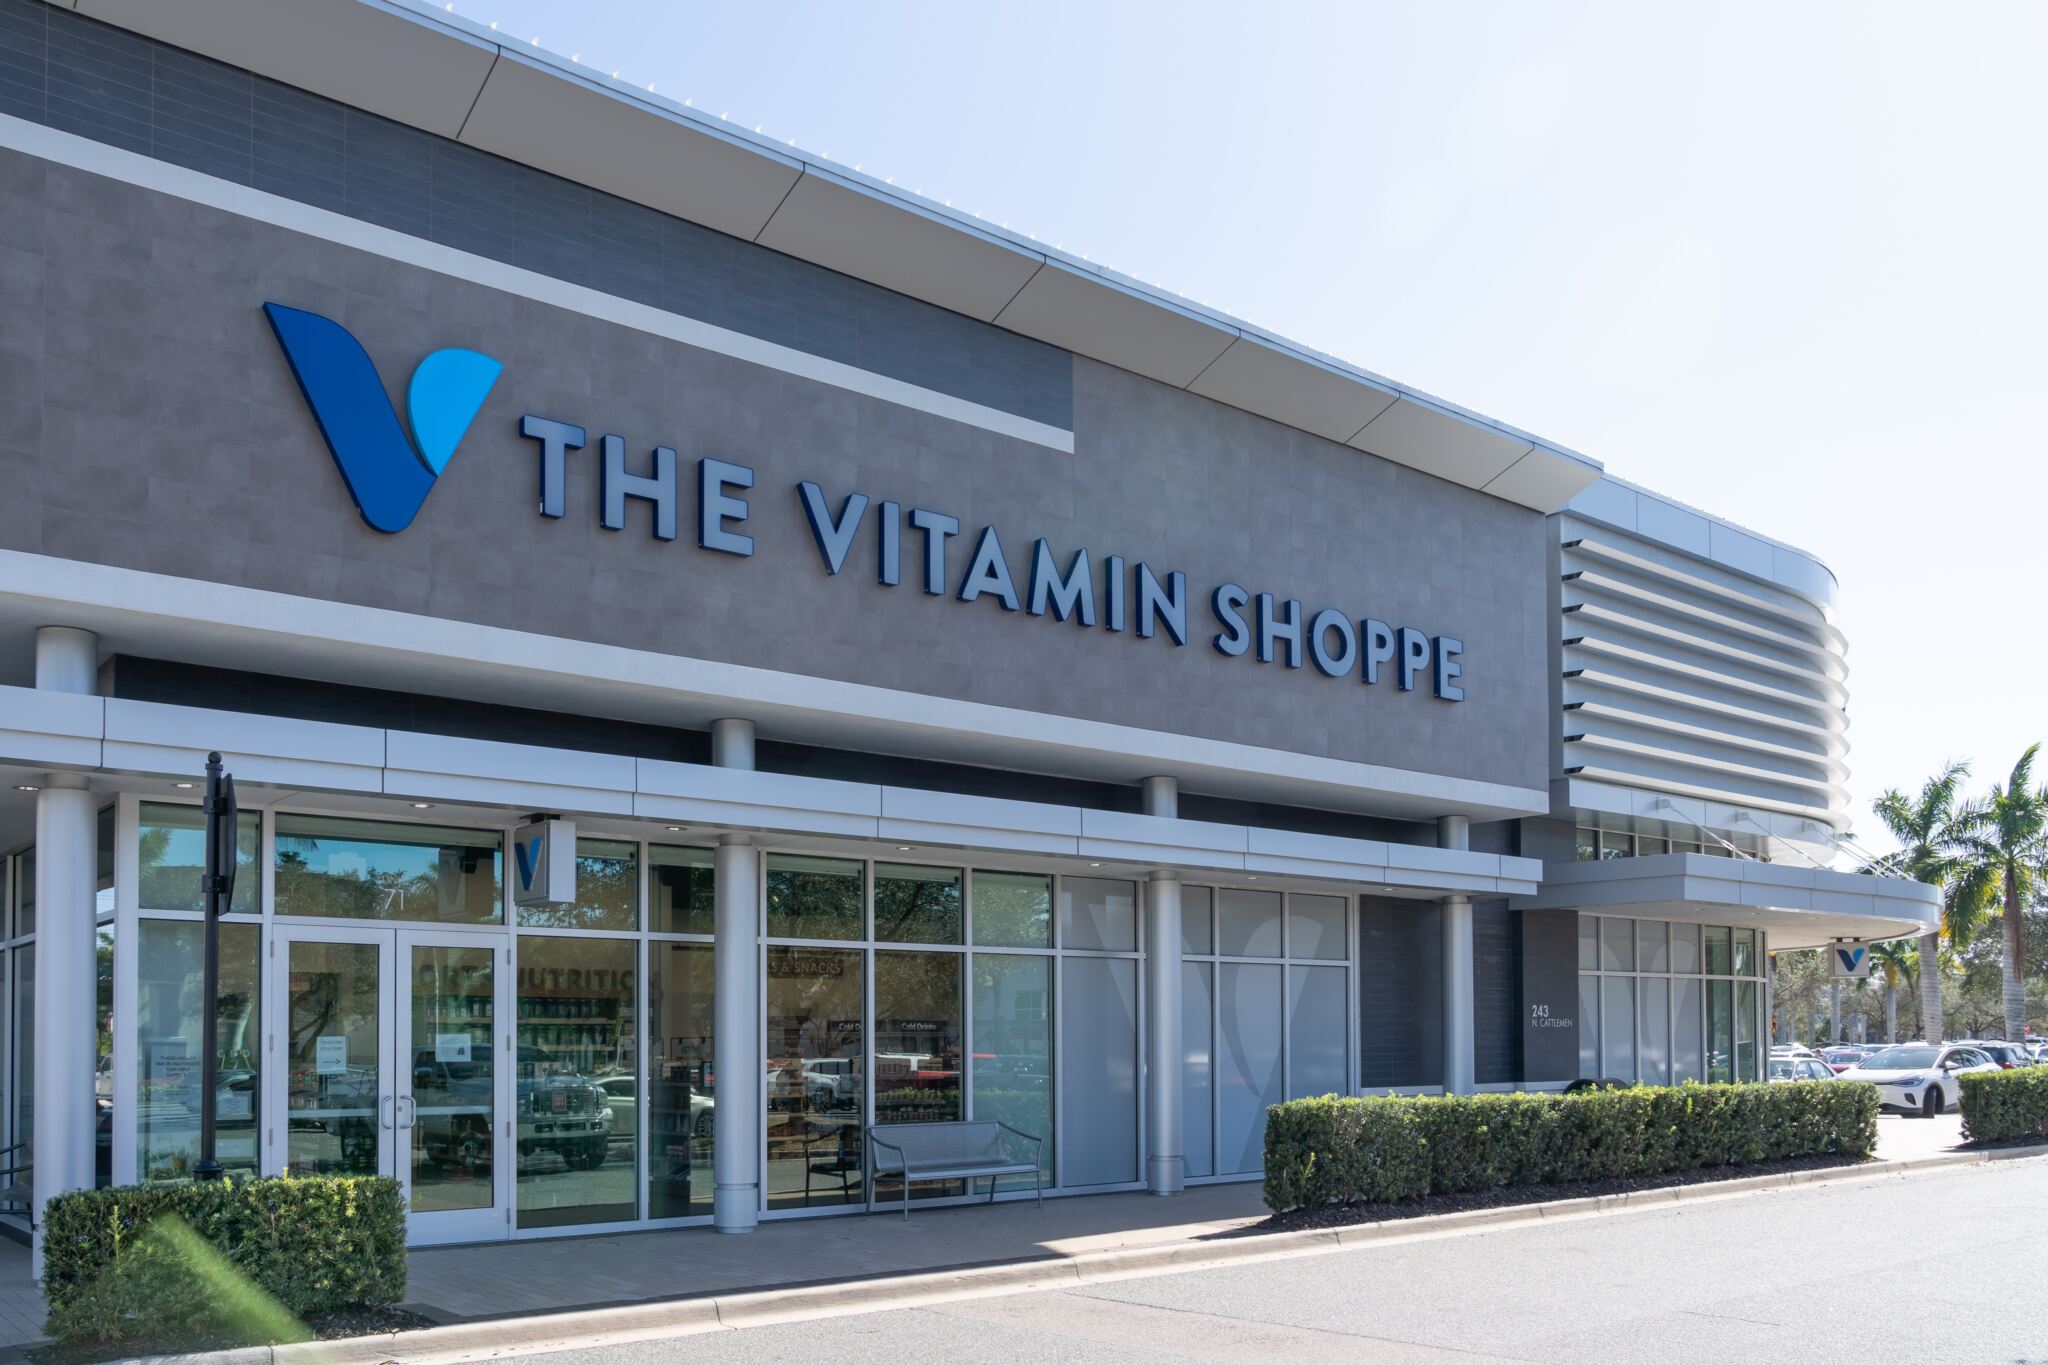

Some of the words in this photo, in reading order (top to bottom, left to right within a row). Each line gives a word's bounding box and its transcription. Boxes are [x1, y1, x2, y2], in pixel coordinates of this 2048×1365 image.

[519, 414, 754, 557] THE
[796, 480, 1188, 646] VITAMIN
[1212, 583, 1465, 702] SHOPPE
[384, 888, 404, 911] 71
[794, 961, 841, 974] SNACKS
[1531, 1004, 1549, 1018] 243
[838, 1022, 854, 1031] Cold
[901, 1022, 916, 1031] Cold
[1540, 1018, 1573, 1028] CATTLEMEN
